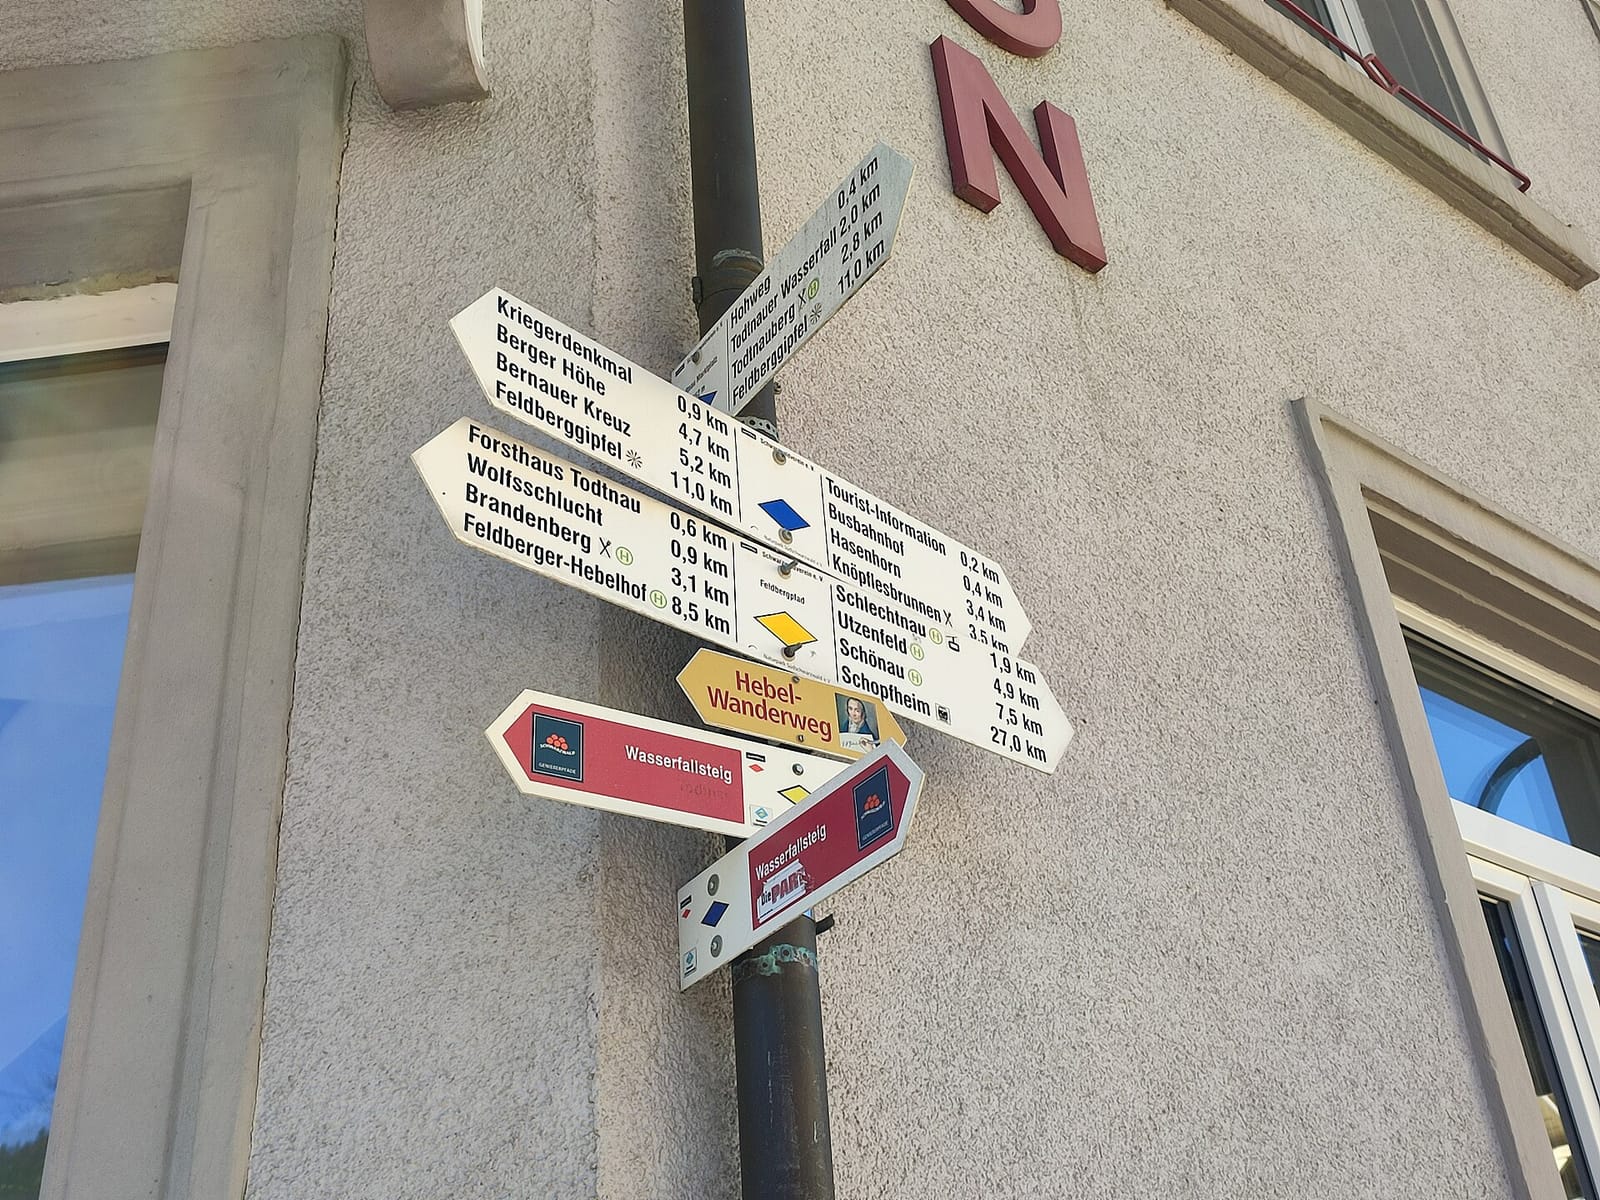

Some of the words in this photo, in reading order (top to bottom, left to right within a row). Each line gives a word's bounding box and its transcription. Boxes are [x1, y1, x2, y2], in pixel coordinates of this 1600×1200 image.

[731, 275, 771, 329] Hohweg
[837, 181, 856, 210] 0,4
[860, 157, 878, 189] km
[731, 294, 779, 353] Todtnauer
[780, 226, 837, 300] Wasserfall
[839, 208, 859, 237] 2,0
[862, 184, 881, 216] km
[732, 303, 796, 379] Todtnauberg
[841, 236, 860, 265] 2,8
[864, 211, 883, 243] km
[496, 295, 633, 385] Kriegerdenkmal
[677, 395, 701, 422] 0,9
[706, 409, 728, 436] km
[732, 315, 809, 406] Feldberggipfel
[837, 262, 862, 295] 11,0
[866, 239, 885, 270] km
[495, 380, 623, 460] Feldberggipfel
[670, 471, 705, 501] 11,0
[709, 489, 733, 516] km
[496, 323, 557, 369] Berger
[563, 357, 606, 397] Höhe
[678, 422, 702, 450] 4,7
[707, 435, 730, 462] km
[496, 351, 578, 412] Bernauer
[584, 397, 632, 437] Kreuz
[679, 448, 704, 475] 5,2
[708, 461, 731, 489] km
[465, 482, 592, 554] Brandenberg
[671, 567, 698, 594] 3,1
[704, 580, 729, 607] km
[467, 452, 603, 527] Wolfsschlucht
[671, 540, 698, 567] 0,9
[703, 552, 728, 579] km
[468, 424, 564, 482] Forsthaus
[569, 467, 641, 514] Todtnau
[670, 511, 698, 539] 0,6
[702, 525, 727, 551] km
[826, 477, 947, 556] Tourist-Information
[960, 551, 980, 573] 0,2
[982, 563, 1000, 585] km
[464, 512, 647, 602] Feldberger-Hebelhof
[672, 597, 699, 623] 8,5
[705, 608, 730, 635] km
[828, 502, 905, 557] Busbahnhof
[963, 575, 983, 598] 0,4
[985, 587, 1003, 609] km
[830, 528, 902, 579] Hasenhorn
[966, 599, 986, 623] 3,4
[988, 610, 1006, 633] km
[832, 554, 942, 624] Knöpflesbrunnen
[990, 635, 1009, 654] km
[735, 670, 802, 705] Hebel-
[836, 584, 927, 639] Schlechtnau
[990, 652, 1012, 674] 1,9
[1016, 662, 1036, 685] km
[837, 610, 908, 655] Utzenfeld
[993, 678, 1015, 700] 4,9
[1019, 688, 1040, 711] km
[839, 637, 905, 681] Schönau
[995, 702, 1018, 727] 7,5
[1022, 713, 1043, 737] km
[624, 745, 733, 785] Wasserfallsteig
[707, 686, 832, 743] Wanderweg
[841, 665, 931, 717] Schopfheim
[990, 726, 1022, 753] 27,0
[1026, 739, 1047, 764] km
[755, 824, 827, 881] Wasserfallsteig
